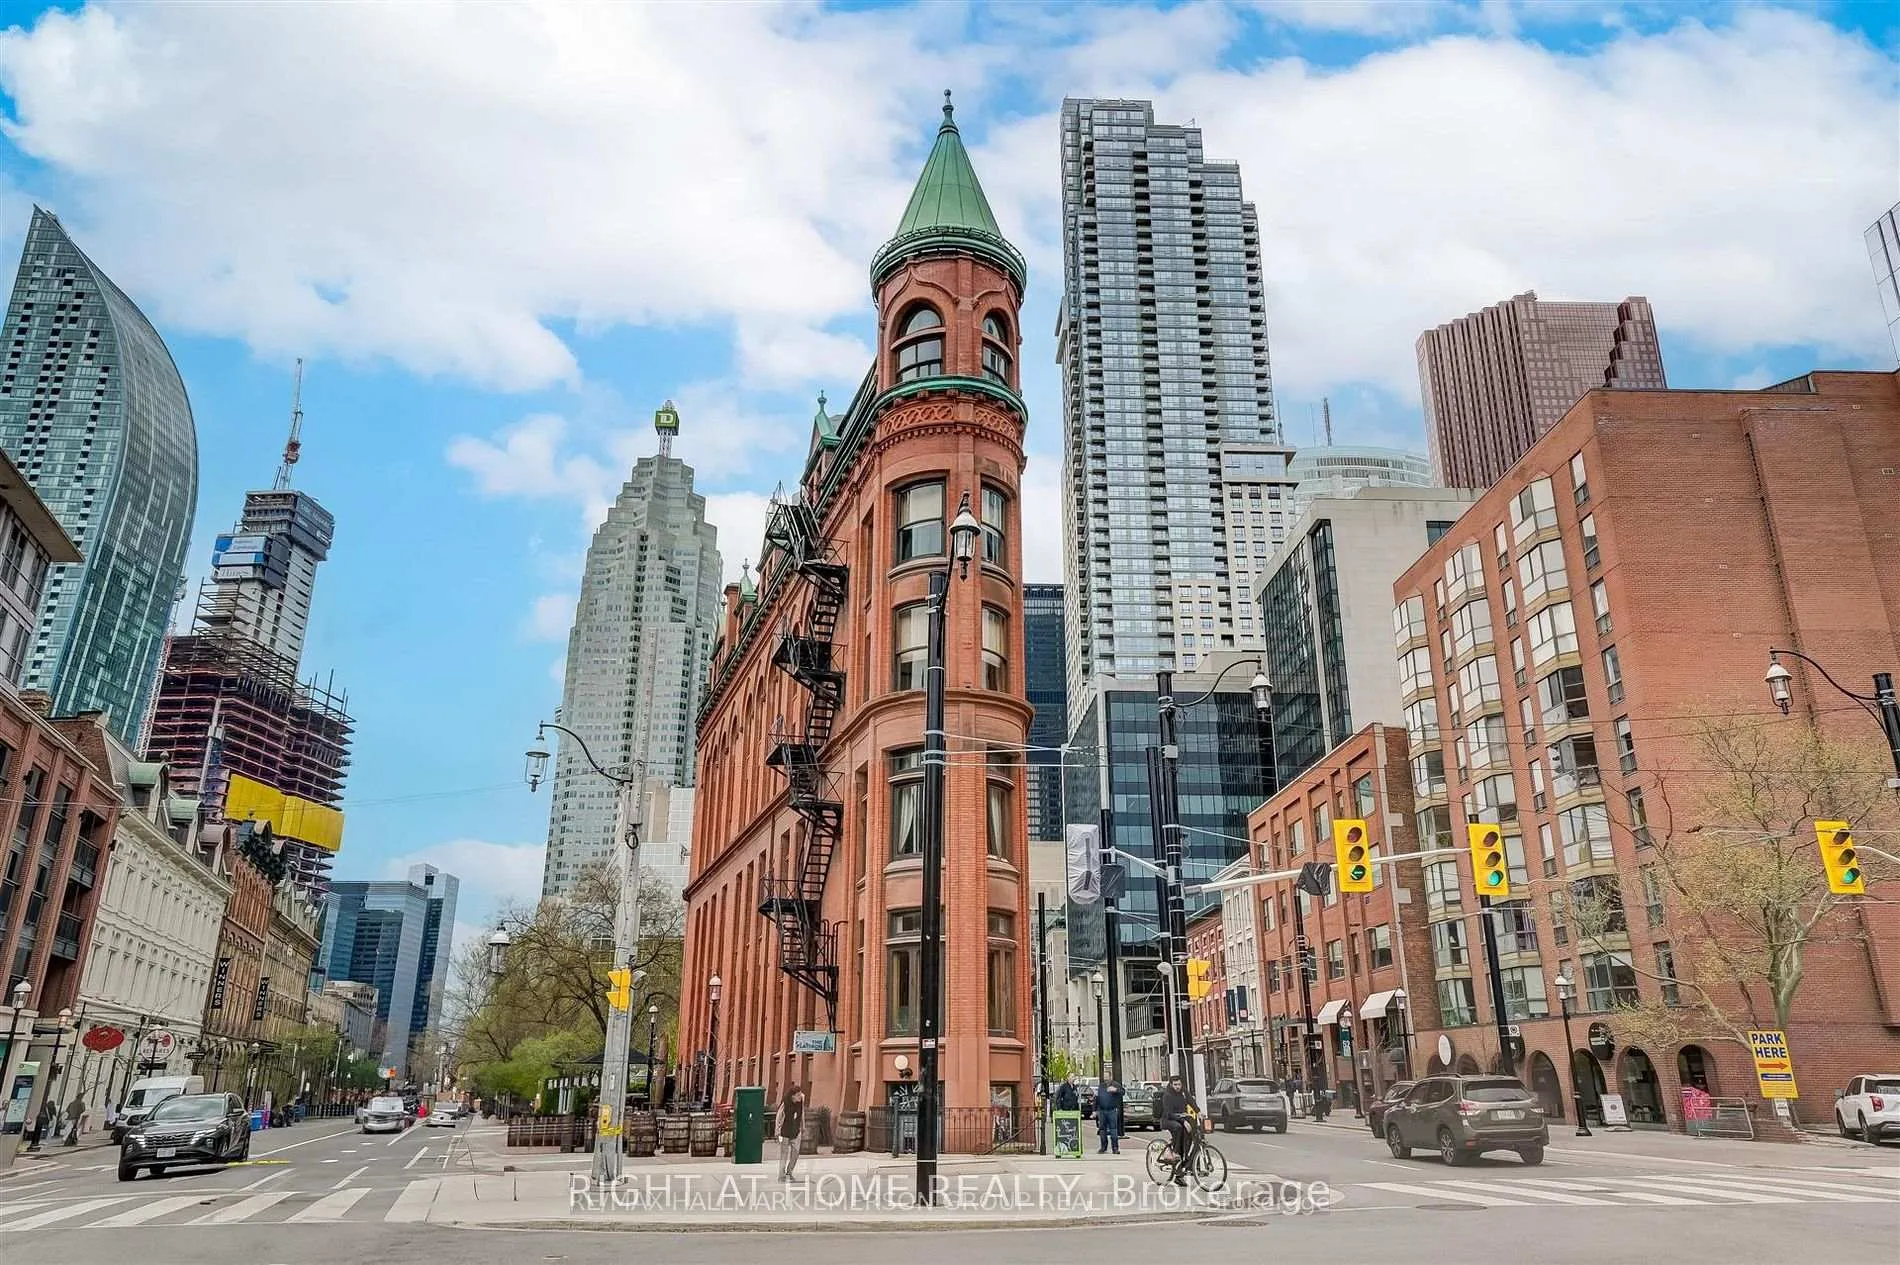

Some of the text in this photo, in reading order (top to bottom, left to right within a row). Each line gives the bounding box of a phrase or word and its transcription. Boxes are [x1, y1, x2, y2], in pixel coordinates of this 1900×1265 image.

[214, 961, 230, 1006] WINNERS
[256, 980, 269, 1018] WINNERS
[1752, 1033, 1784, 1045] PARK
[1754, 1046, 1788, 1059] HERE
